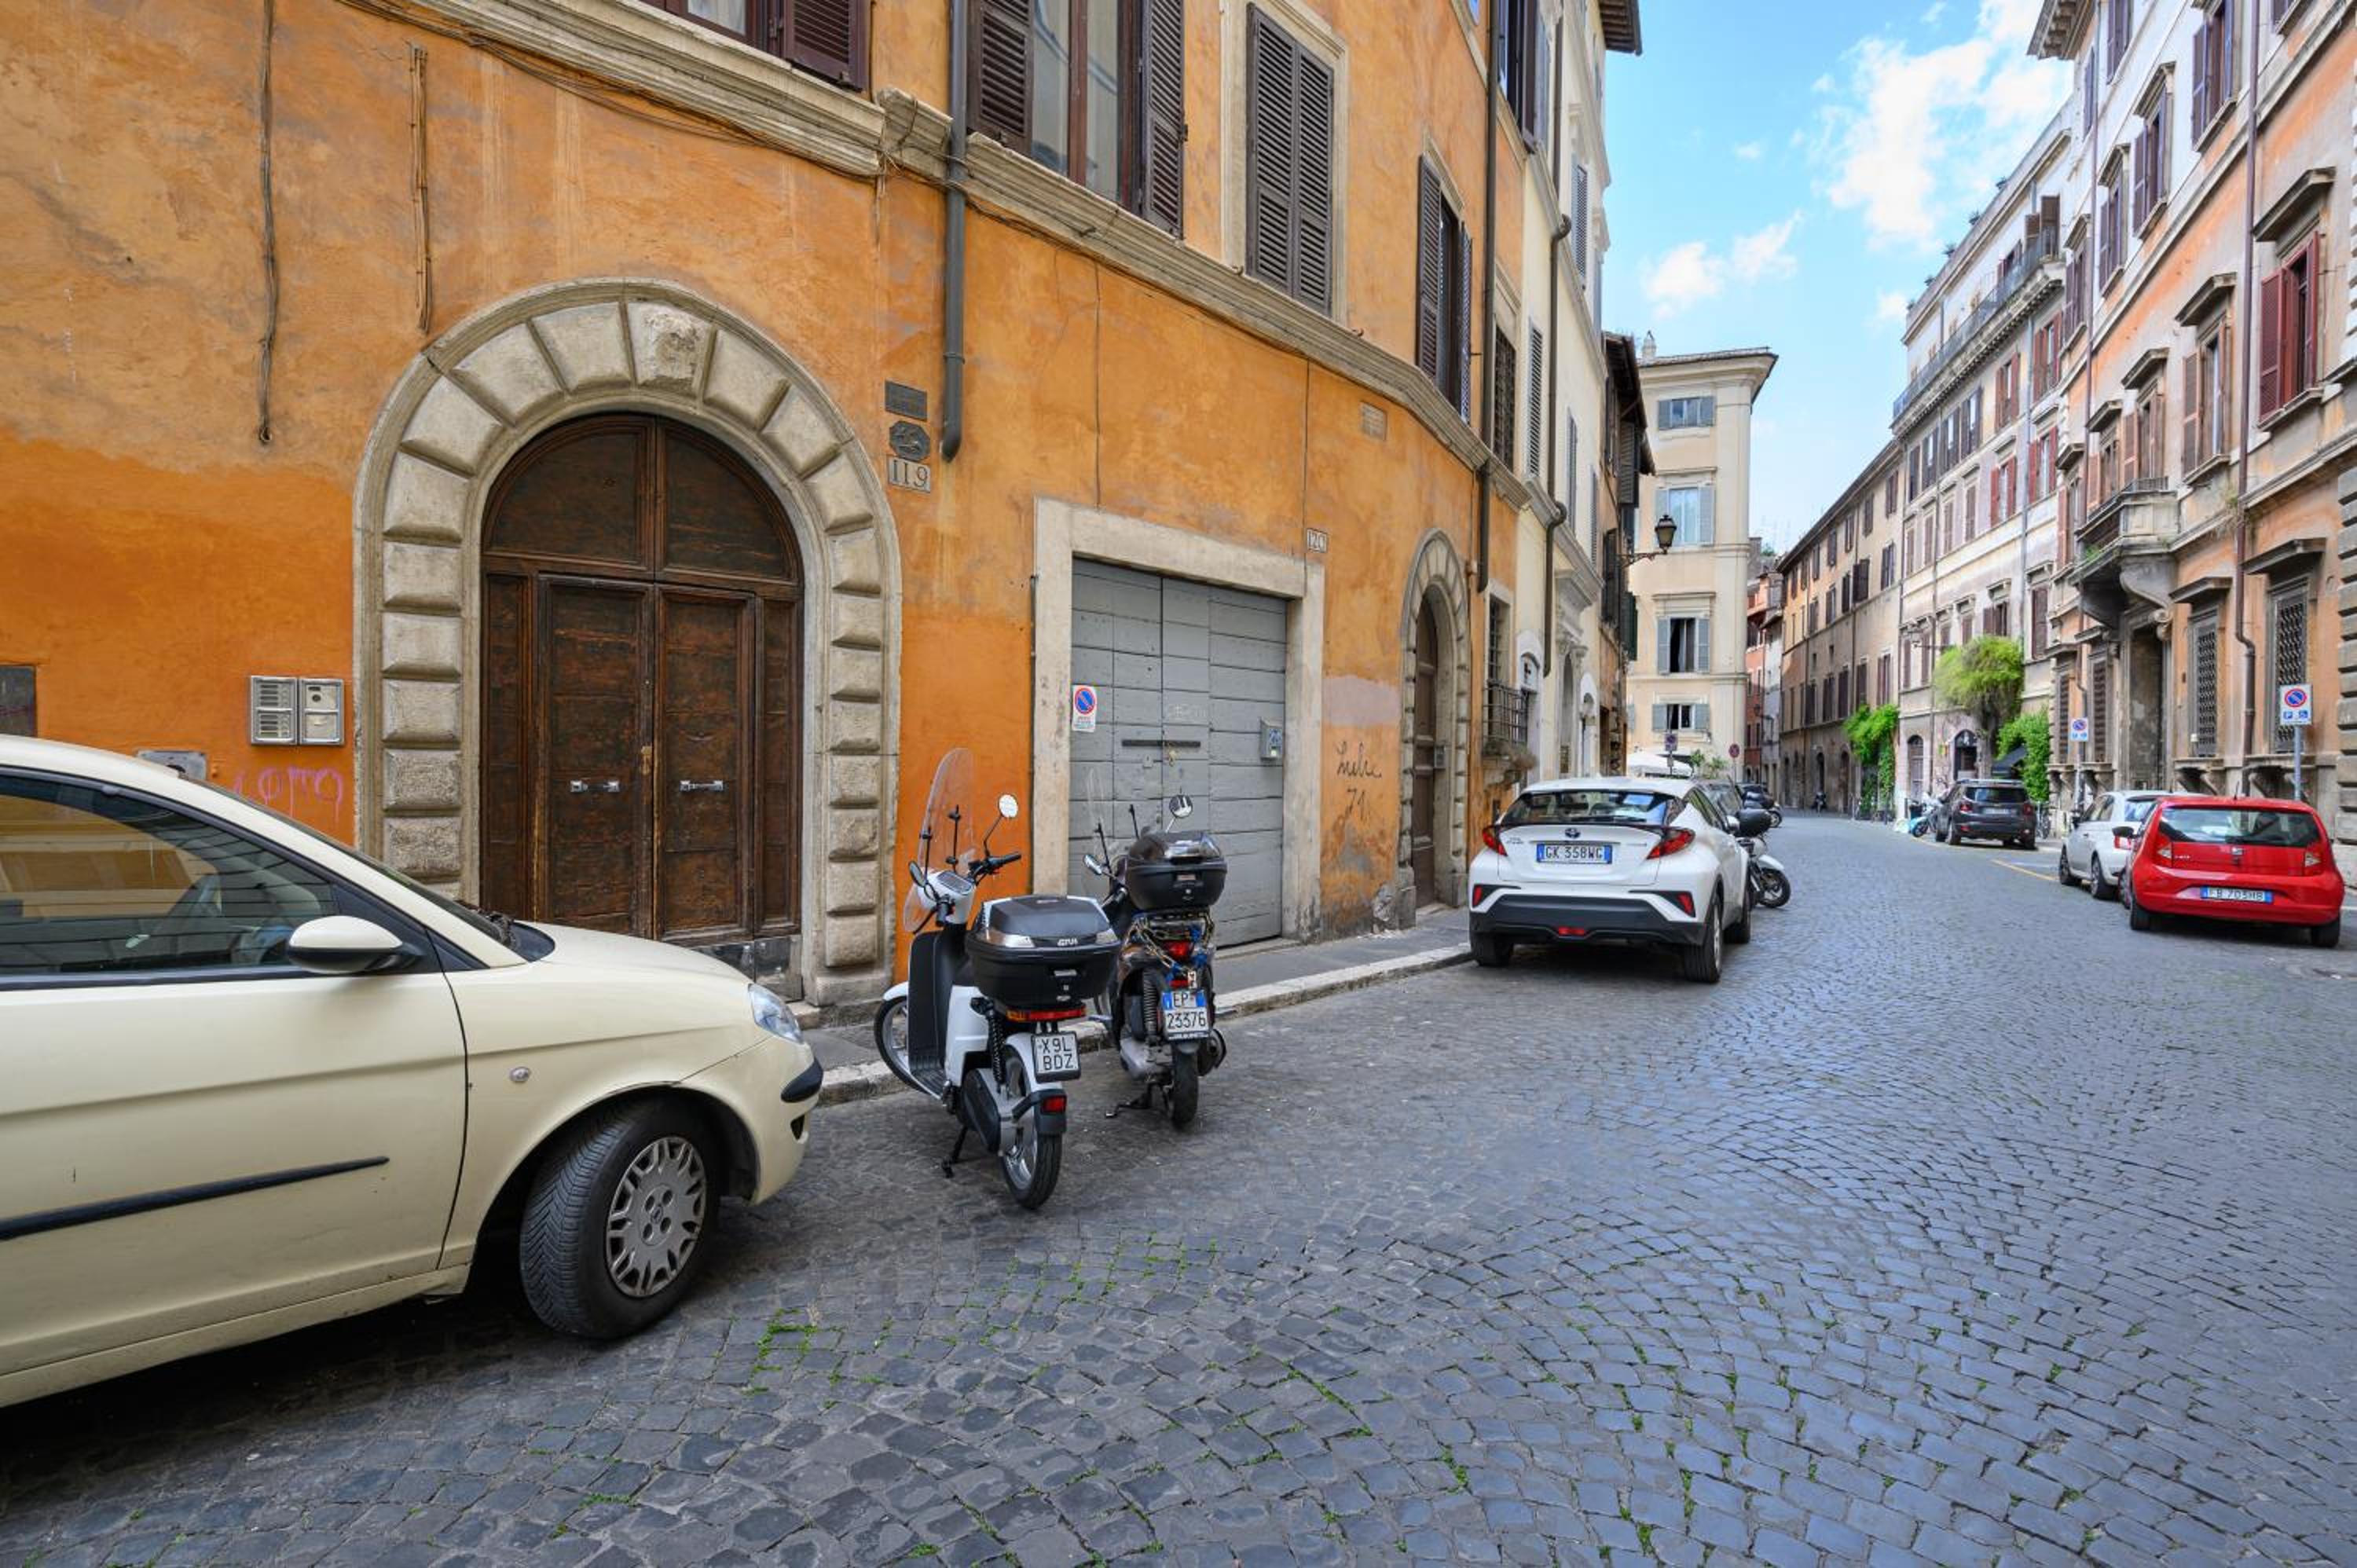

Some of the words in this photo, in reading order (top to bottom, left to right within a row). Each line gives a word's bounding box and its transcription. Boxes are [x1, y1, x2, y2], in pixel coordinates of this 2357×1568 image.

[893, 460, 928, 488] 119
[1545, 845, 1560, 859] GK
[1174, 992, 1189, 1007] EP
[1168, 1011, 1206, 1029] 23376
[1042, 1036, 1072, 1053] X9L
[1043, 1053, 1075, 1070] BDZ
